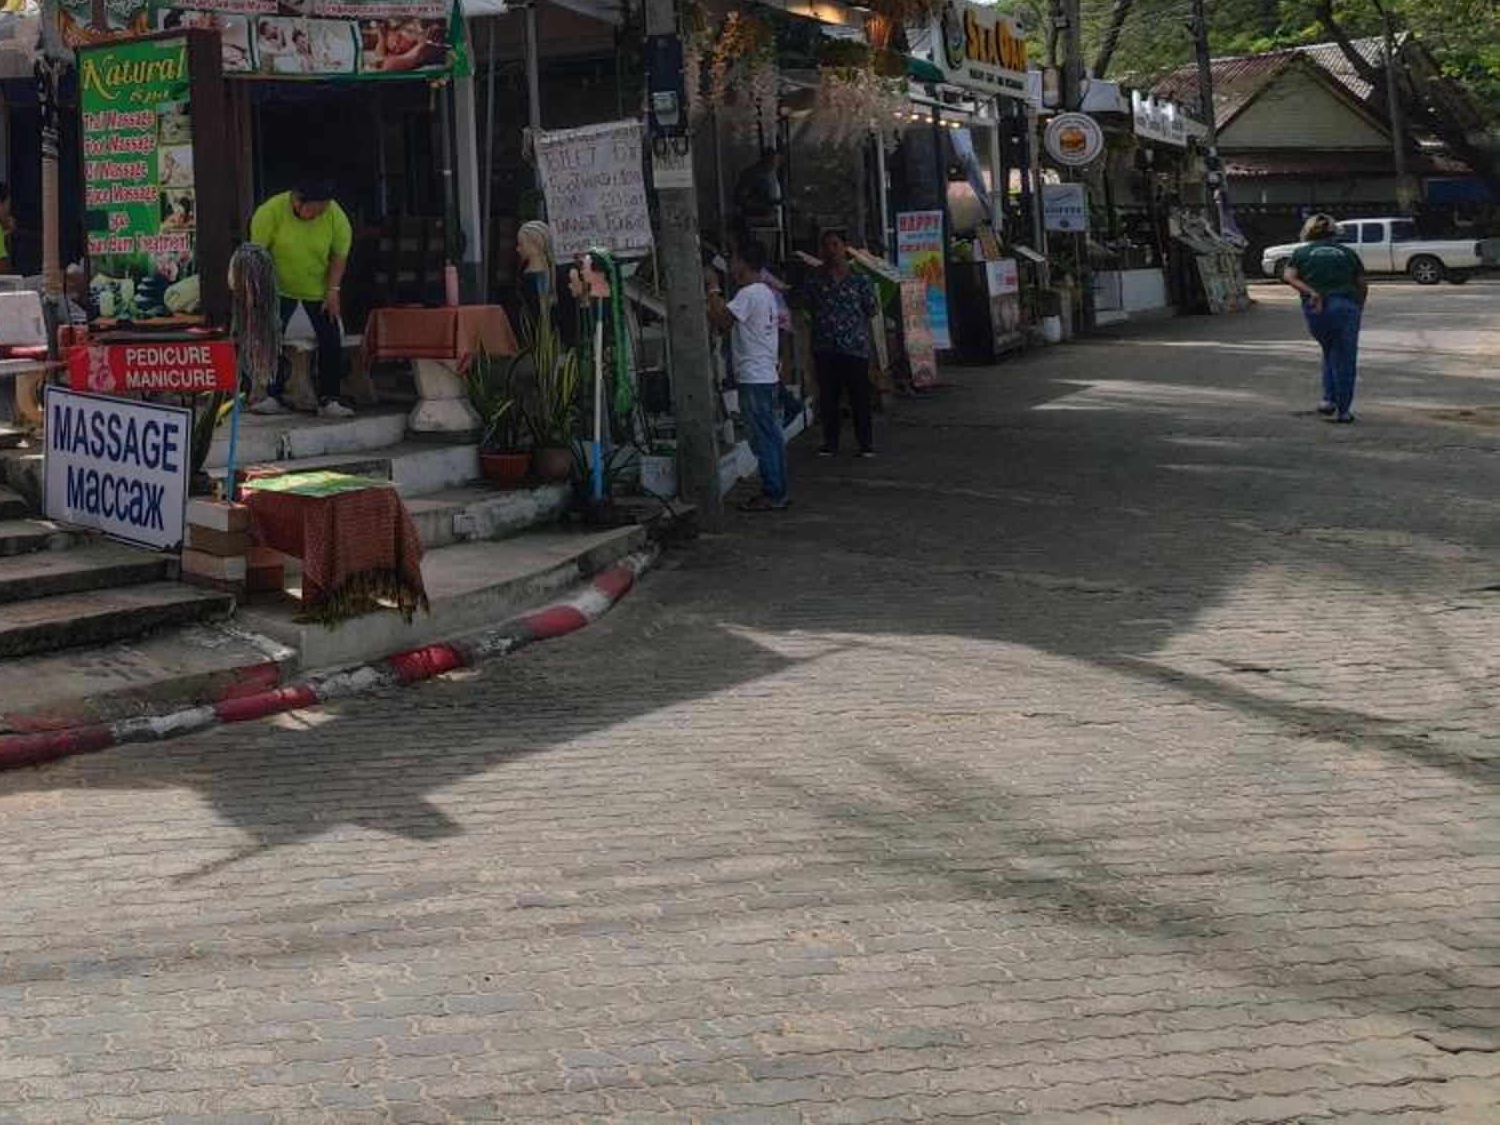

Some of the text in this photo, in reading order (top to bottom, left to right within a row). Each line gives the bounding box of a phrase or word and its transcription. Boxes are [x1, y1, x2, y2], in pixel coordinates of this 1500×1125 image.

[84, 44, 187, 100] Natural
[107, 108, 156, 131] Massage
[109, 134, 157, 154] Massage
[102, 160, 148, 179] Massage
[111, 184, 158, 204] Massage
[126, 346, 213, 367] PEDICURE
[126, 369, 217, 389] MANICURE
[53, 404, 179, 473] MASSAGE
